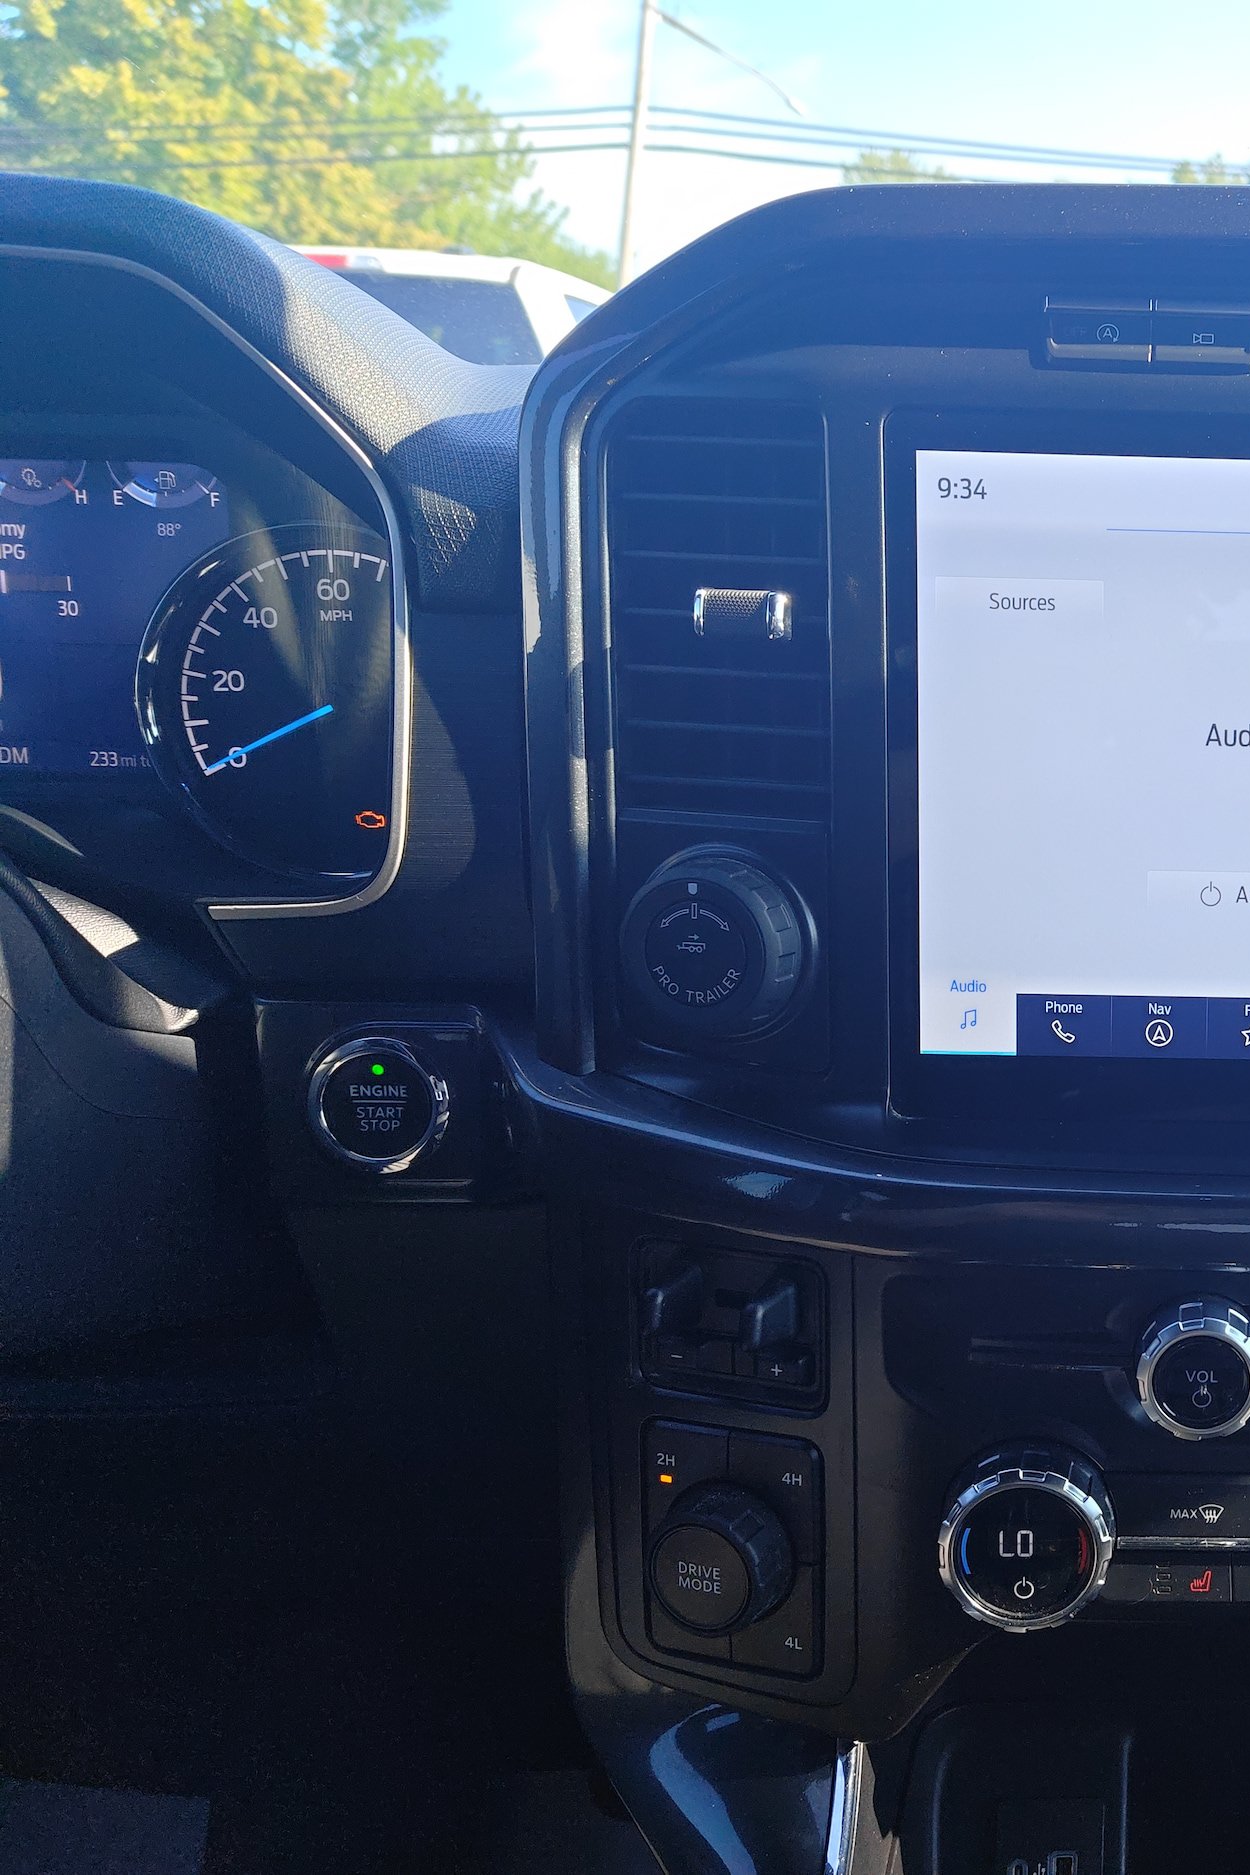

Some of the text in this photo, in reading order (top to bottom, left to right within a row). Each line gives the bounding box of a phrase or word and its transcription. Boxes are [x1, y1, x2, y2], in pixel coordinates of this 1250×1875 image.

[75, 489, 88, 505] H
[937, 477, 988, 501] 9:34
[113, 490, 124, 506] E
[210, 492, 219, 507] F
[0, 523, 26, 540] my
[0, 543, 26, 560] PG
[316, 578, 350, 601] 60
[58, 600, 79, 616] 30
[988, 592, 1057, 611] Sources
[243, 606, 278, 629] 40
[319, 610, 353, 622] MPH
[212, 670, 245, 692] 20
[90, 751, 118, 767] 233
[121, 755, 136, 767] mi
[652, 965, 742, 1004] PRO TRAILER
[950, 980, 987, 993] Audio
[1045, 1001, 1083, 1014] Phone
[1148, 1003, 1172, 1015] Nav
[350, 1085, 408, 1098] ENGINE
[356, 1107, 404, 1119] START
[360, 1120, 400, 1132] STOP
[1185, 1370, 1219, 1383] VOL
[656, 1453, 676, 1467] 2H
[781, 1472, 803, 1487] 4H
[1170, 1509, 1198, 1519] MAX
[677, 1560, 721, 1581] DRIVE
[678, 1575, 722, 1595] MODE
[784, 1636, 803, 1650] 4L
